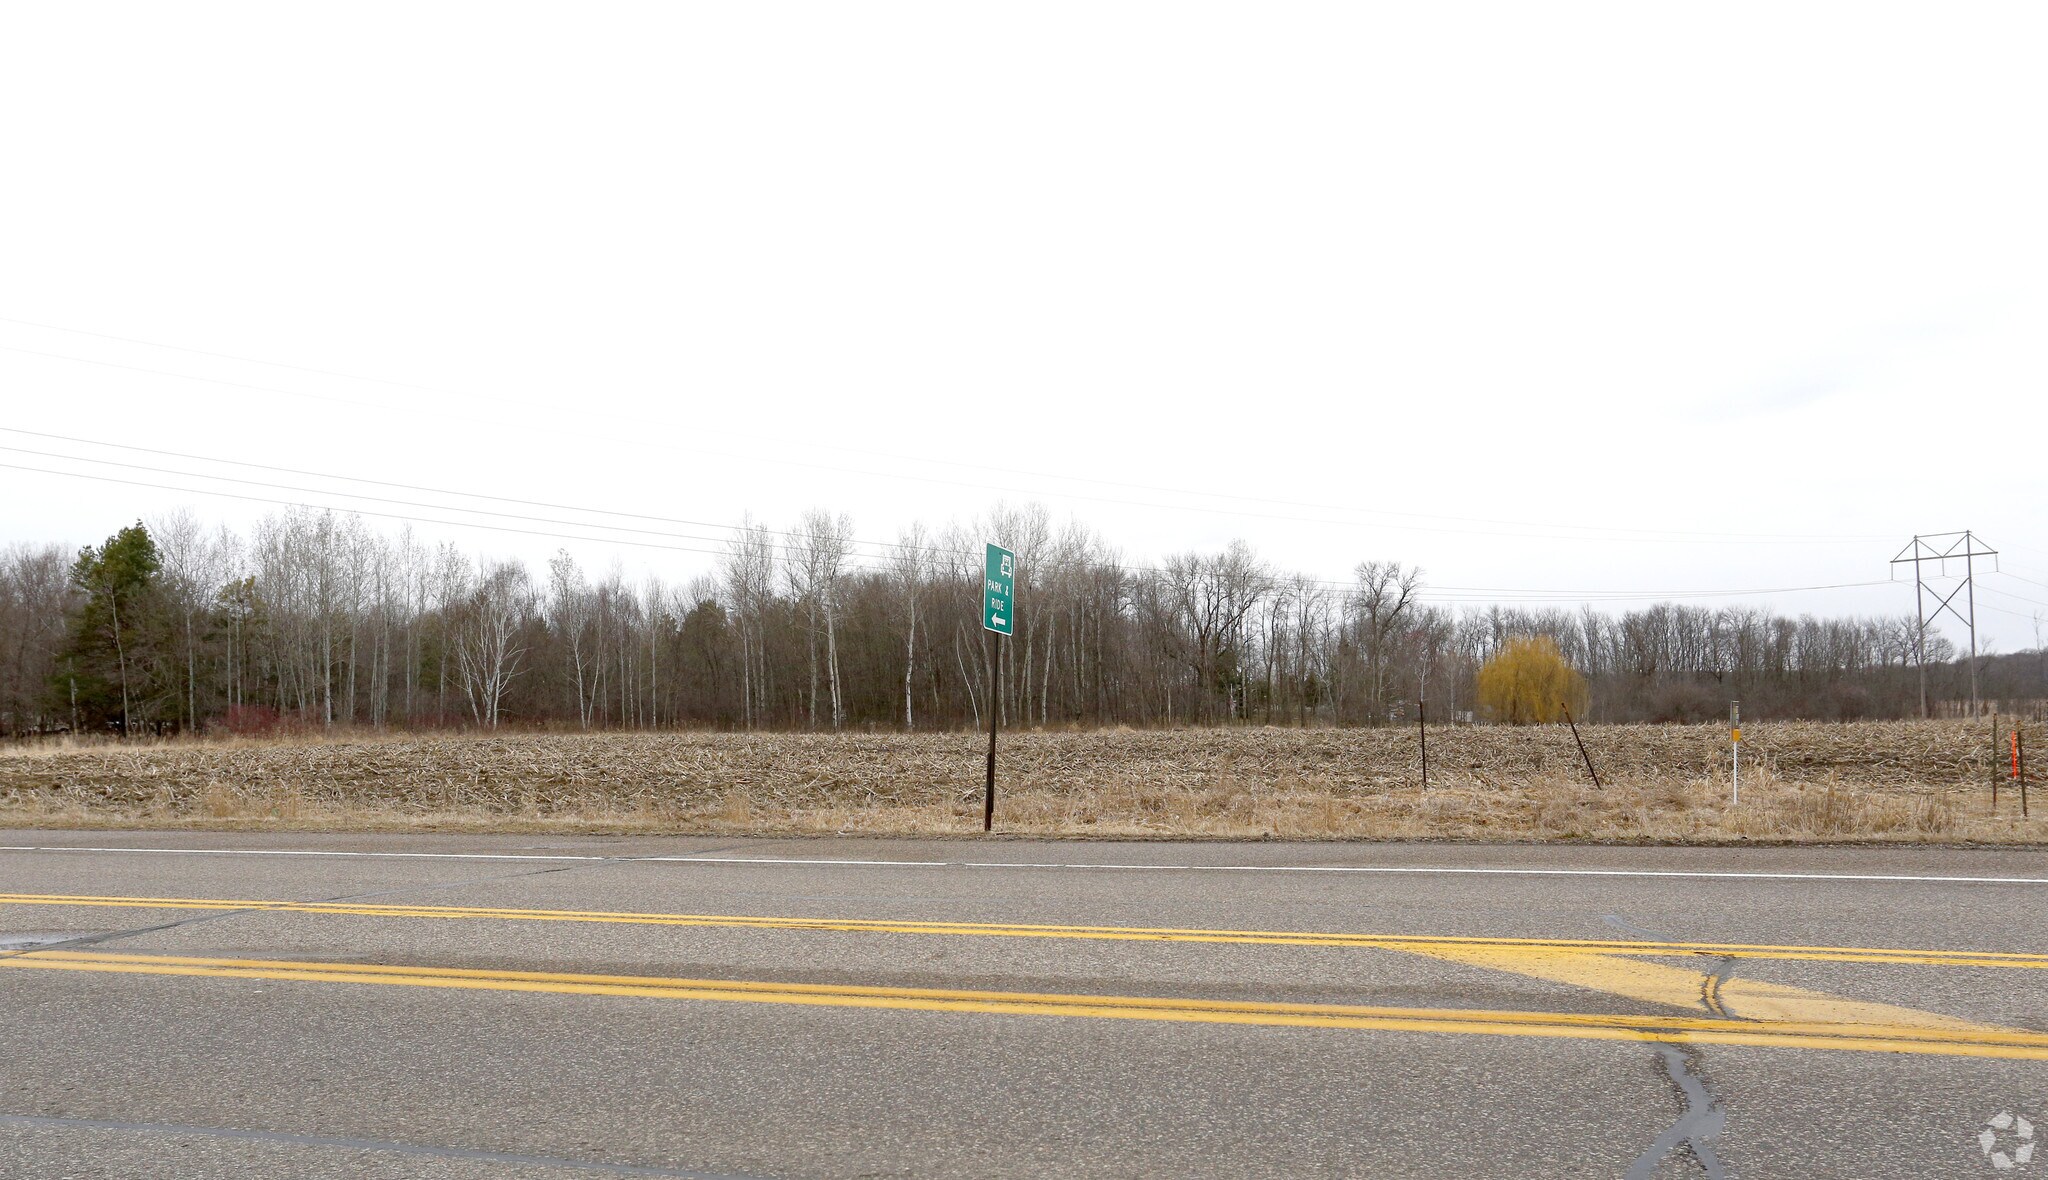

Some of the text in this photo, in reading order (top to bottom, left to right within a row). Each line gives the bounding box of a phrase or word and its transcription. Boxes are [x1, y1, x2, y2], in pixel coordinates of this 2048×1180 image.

[987, 579, 1009, 597] PARK &
[991, 597, 1004, 612] RIDE
